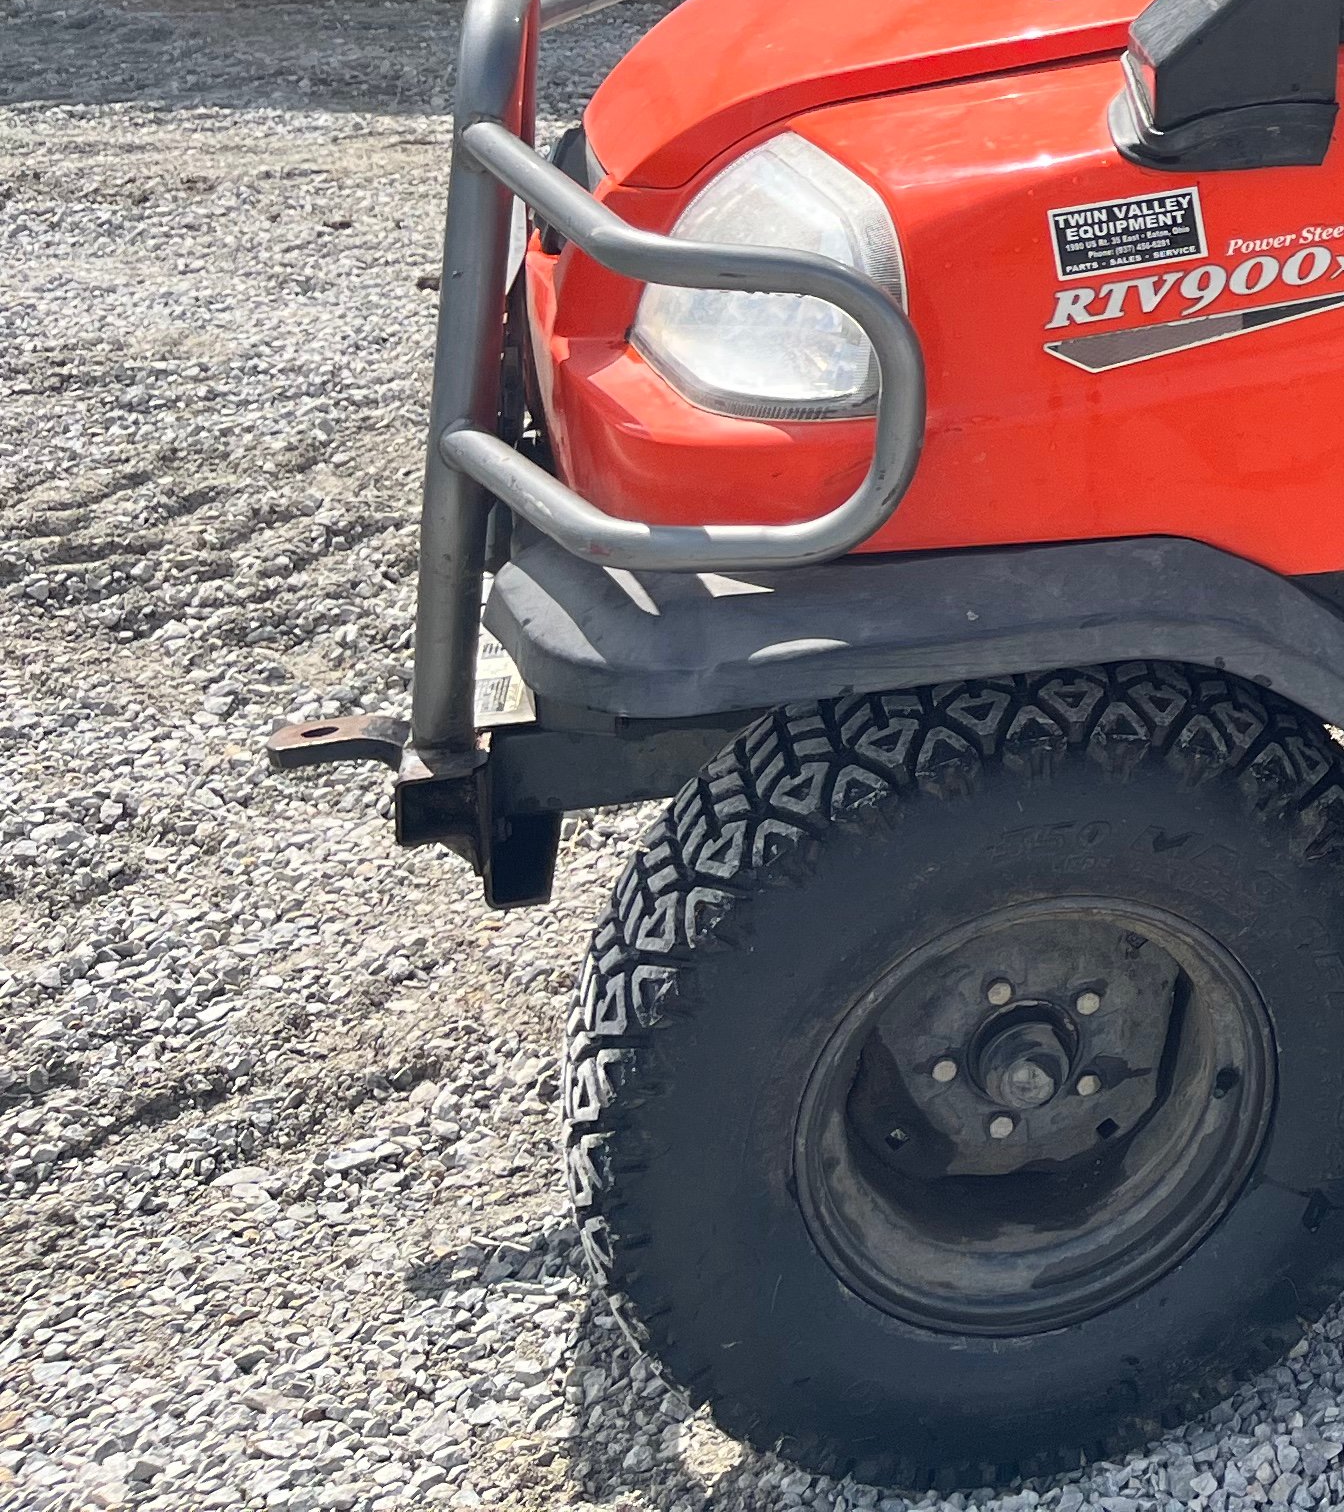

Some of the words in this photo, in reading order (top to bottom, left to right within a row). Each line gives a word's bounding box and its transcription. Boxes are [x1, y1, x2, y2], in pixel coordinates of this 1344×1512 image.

[1054, 208, 1108, 229] TWIN
[1112, 195, 1192, 219] VALLEY
[1065, 210, 1186, 241] EQUIPMENT
[1065, 261, 1099, 273] PARTS
[1109, 254, 1142, 266] SALES
[1153, 245, 1197, 259] SERVICE
[1225, 232, 1297, 258] Power
